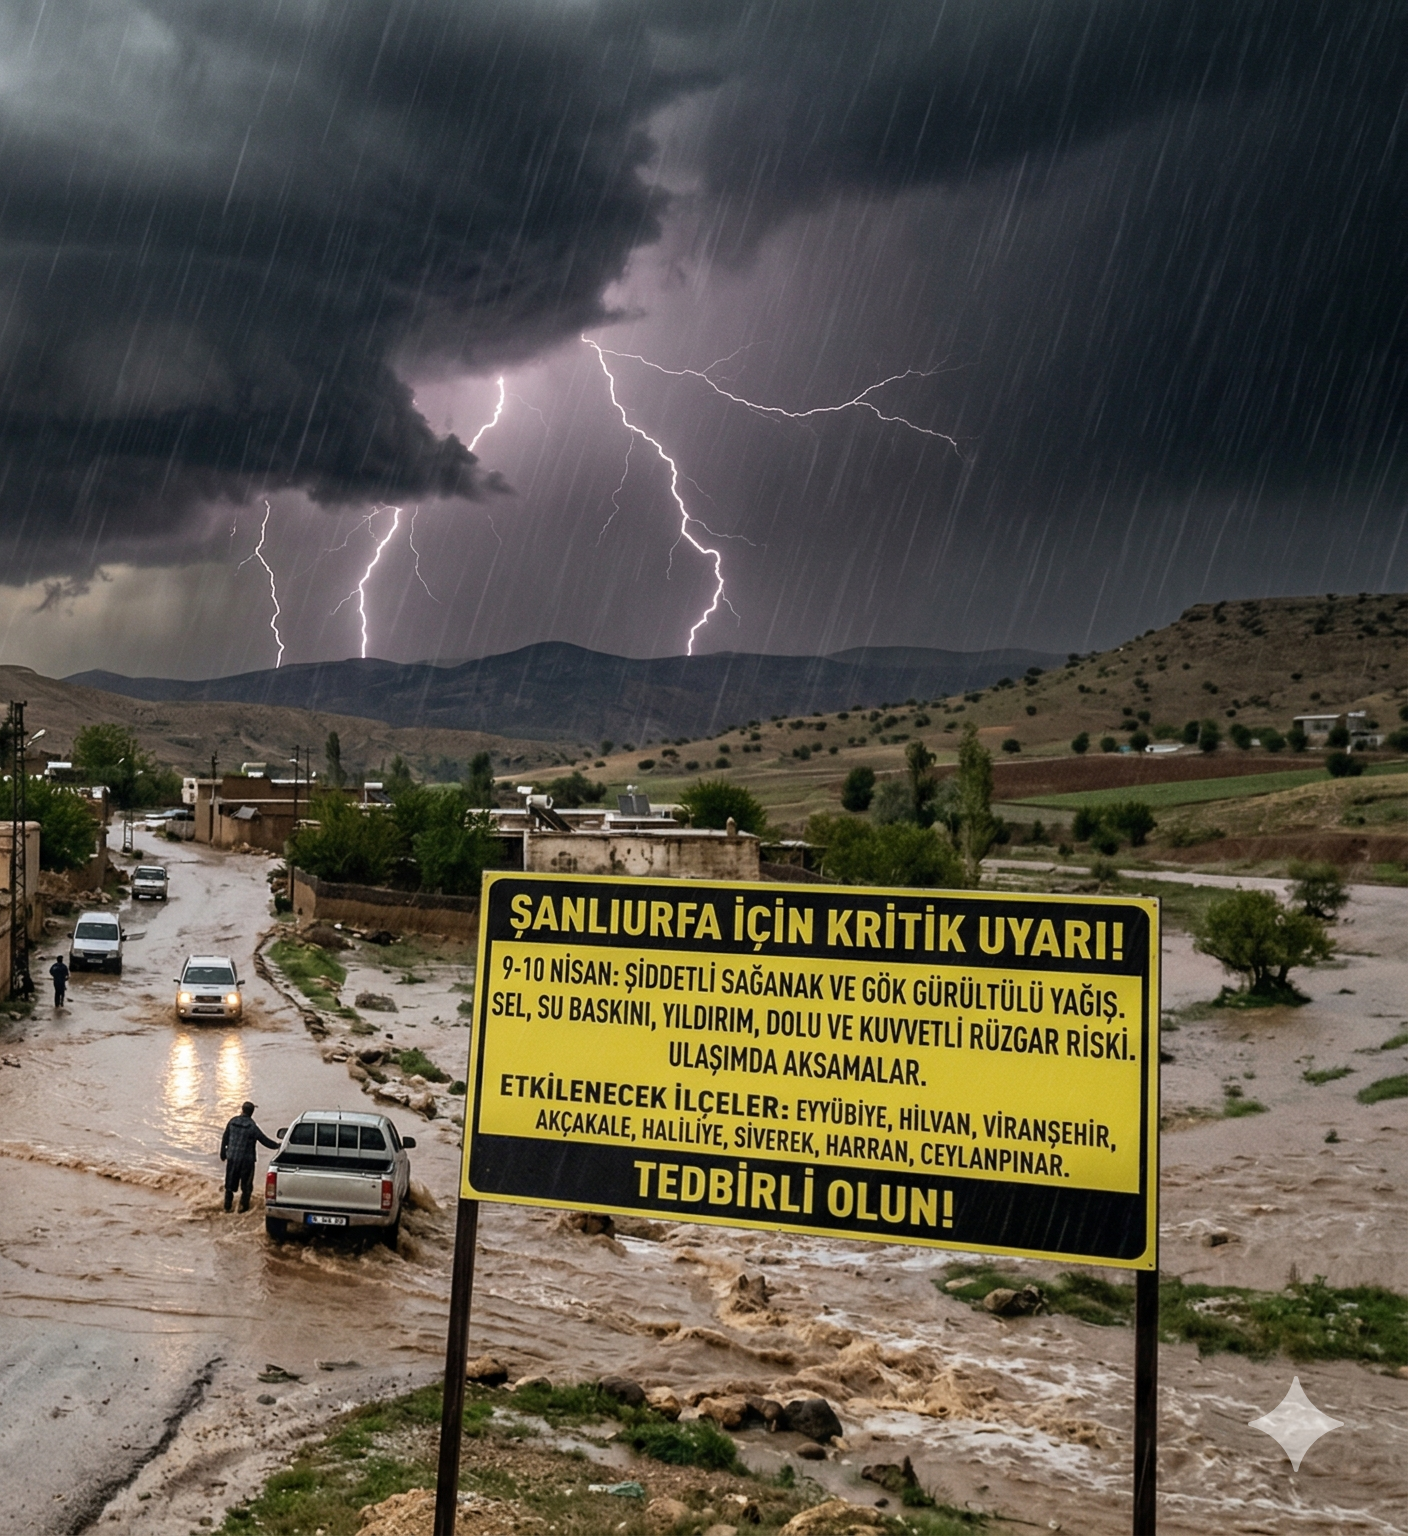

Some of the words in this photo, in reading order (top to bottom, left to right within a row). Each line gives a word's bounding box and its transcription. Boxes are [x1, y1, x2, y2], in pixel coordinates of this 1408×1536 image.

[509, 893, 722, 941] ŞANLIURFA
[734, 895, 814, 952] İÇİN
[827, 902, 967, 953] KRİTİK
[979, 916, 1124, 961] UYARI!
[502, 955, 545, 982] 9-10
[550, 952, 619, 987] NİSAN:
[624, 957, 716, 994] ŞİDDETLİ
[721, 963, 824, 1000] SAĞANAK
[829, 974, 857, 1002] VE
[862, 971, 907, 1005] GÖK
[913, 974, 1044, 1014] GÜRÜLTÜLÜ
[1049, 982, 1125, 1025] YAĞIŞ.
[491, 991, 532, 1023] SEL,
[537, 994, 564, 1020] SU
[569, 996, 657, 1032] BASKINI,
[662, 1002, 760, 1039] YILDIRIM,
[766, 1009, 822, 1039] DOLU
[827, 1013, 854, 1041] VE
[859, 1015, 963, 1049] KUVVETLİ
[969, 1018, 1059, 1056] RÜZGAR
[1066, 1024, 1136, 1061] RİSKİ.
[669, 1040, 778, 1077] ULAŞIMDA
[782, 1049, 927, 1087] AKSAMALAR.
[500, 1072, 667, 1110] ETKİLENECEK
[674, 1082, 789, 1120] İLÇELER:
[796, 1097, 893, 1133] EYYÜBİYE,
[899, 1103, 977, 1140] HİLVAN,
[982, 1110, 1117, 1154] VİRANŞEHİR,
[535, 1108, 636, 1142] AKÇAKALE,
[642, 1116, 729, 1151] HALİLİYE,
[733, 1121, 820, 1159] SİVEREK,
[826, 1133, 915, 1168] HARRAN,
[920, 1142, 1070, 1178] CEYLANPINAR.
[633, 1160, 814, 1214] TEDBİRLİ
[827, 1179, 953, 1229] OLUN!
